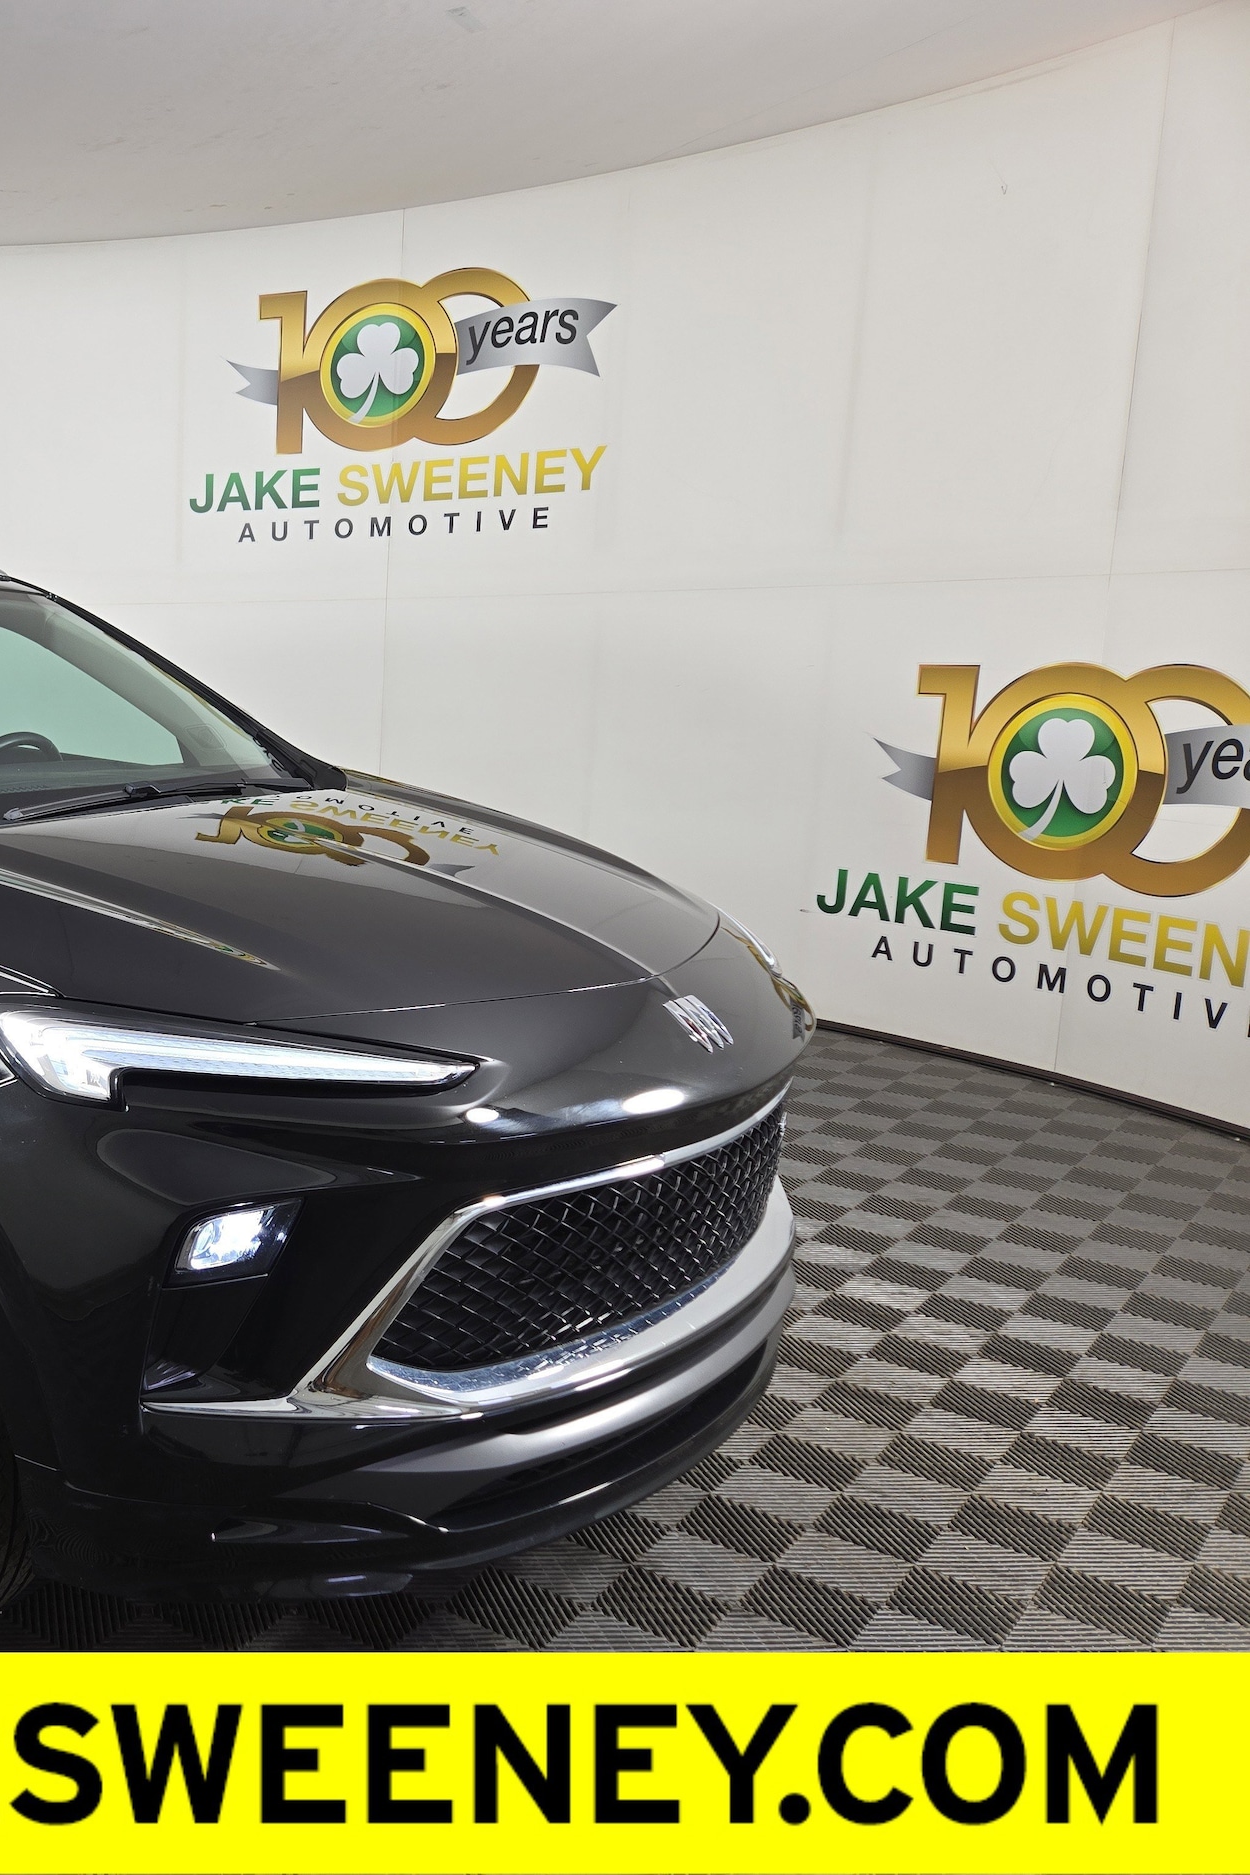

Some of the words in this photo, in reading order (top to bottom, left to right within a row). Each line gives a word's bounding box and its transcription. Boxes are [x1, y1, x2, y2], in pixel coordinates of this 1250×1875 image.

[259, 267, 540, 454] 100
[466, 305, 579, 366] years
[189, 468, 321, 513] JAKE
[337, 445, 607, 507] SWEENEY
[238, 507, 549, 543] AUTOMOTIVE
[816, 868, 980, 936] JAKE
[871, 935, 1250, 1038] AUTOMOTIV
